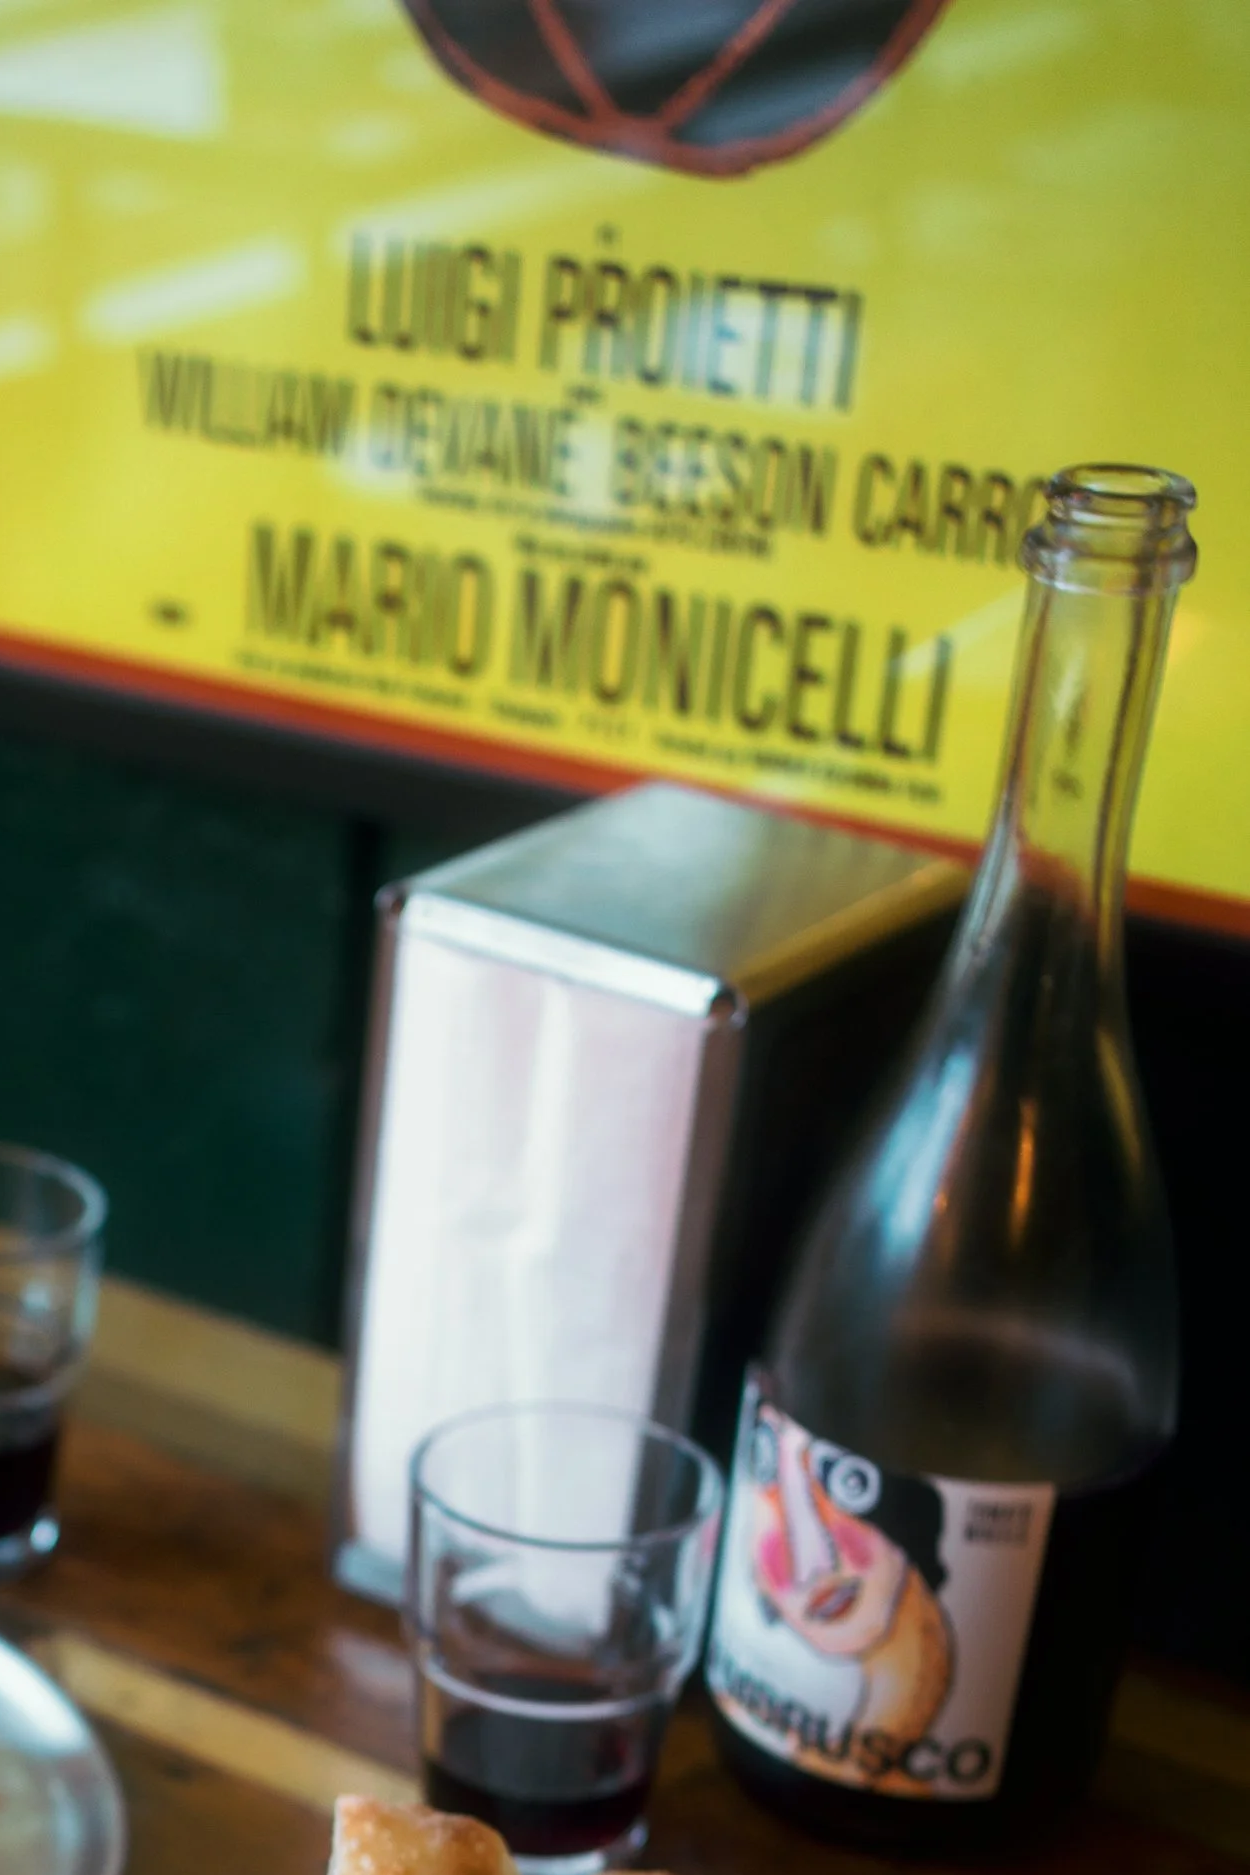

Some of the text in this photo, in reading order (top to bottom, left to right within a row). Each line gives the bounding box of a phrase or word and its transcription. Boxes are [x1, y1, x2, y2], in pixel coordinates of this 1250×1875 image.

[349, 235, 863, 414] LUIGI PROIETTI
[137, 345, 354, 460] WILLIAM
[369, 380, 579, 501] DEVANE
[609, 412, 836, 538] BEESON
[245, 521, 493, 681] MARIO
[508, 564, 954, 766] MONICELLI
